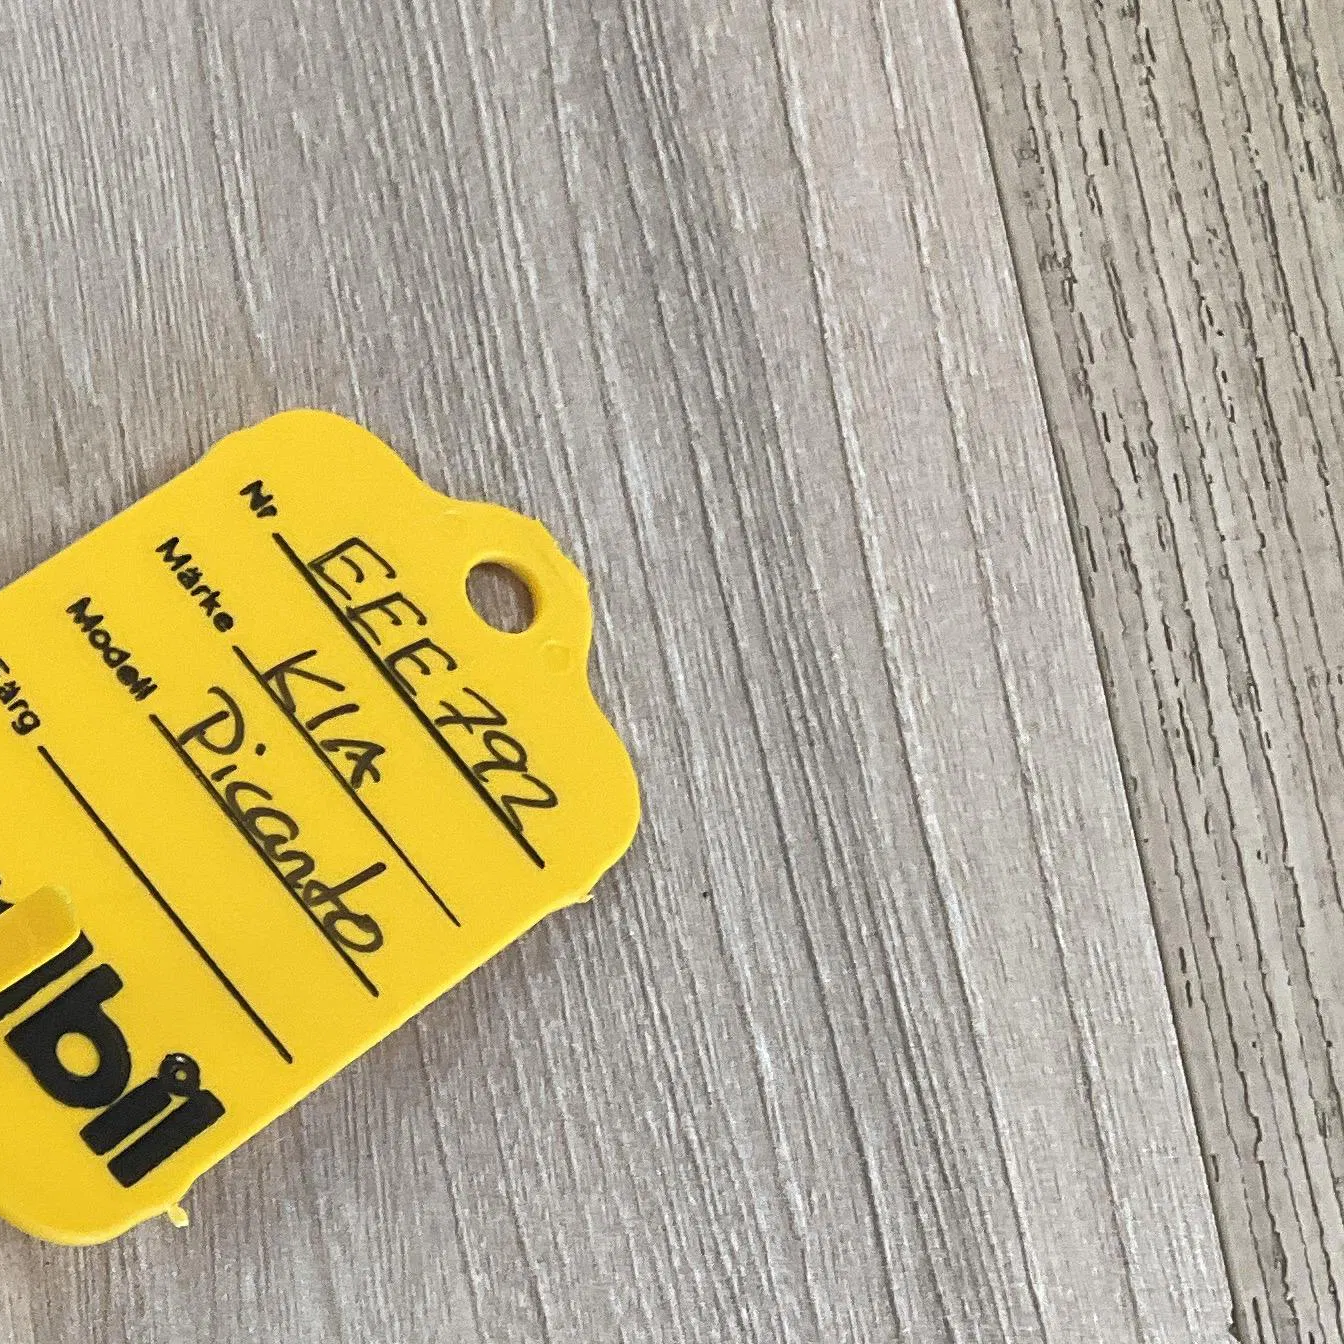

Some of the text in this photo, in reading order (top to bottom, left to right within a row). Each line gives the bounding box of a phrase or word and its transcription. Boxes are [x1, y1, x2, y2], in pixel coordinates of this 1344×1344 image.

[240, 480, 278, 518] Nr
[155, 536, 234, 633] Märke
[66, 597, 158, 701] Modell
[308, 537, 558, 832] EEE792
[262, 649, 386, 790] KIA
[178, 686, 387, 953] Picanto
